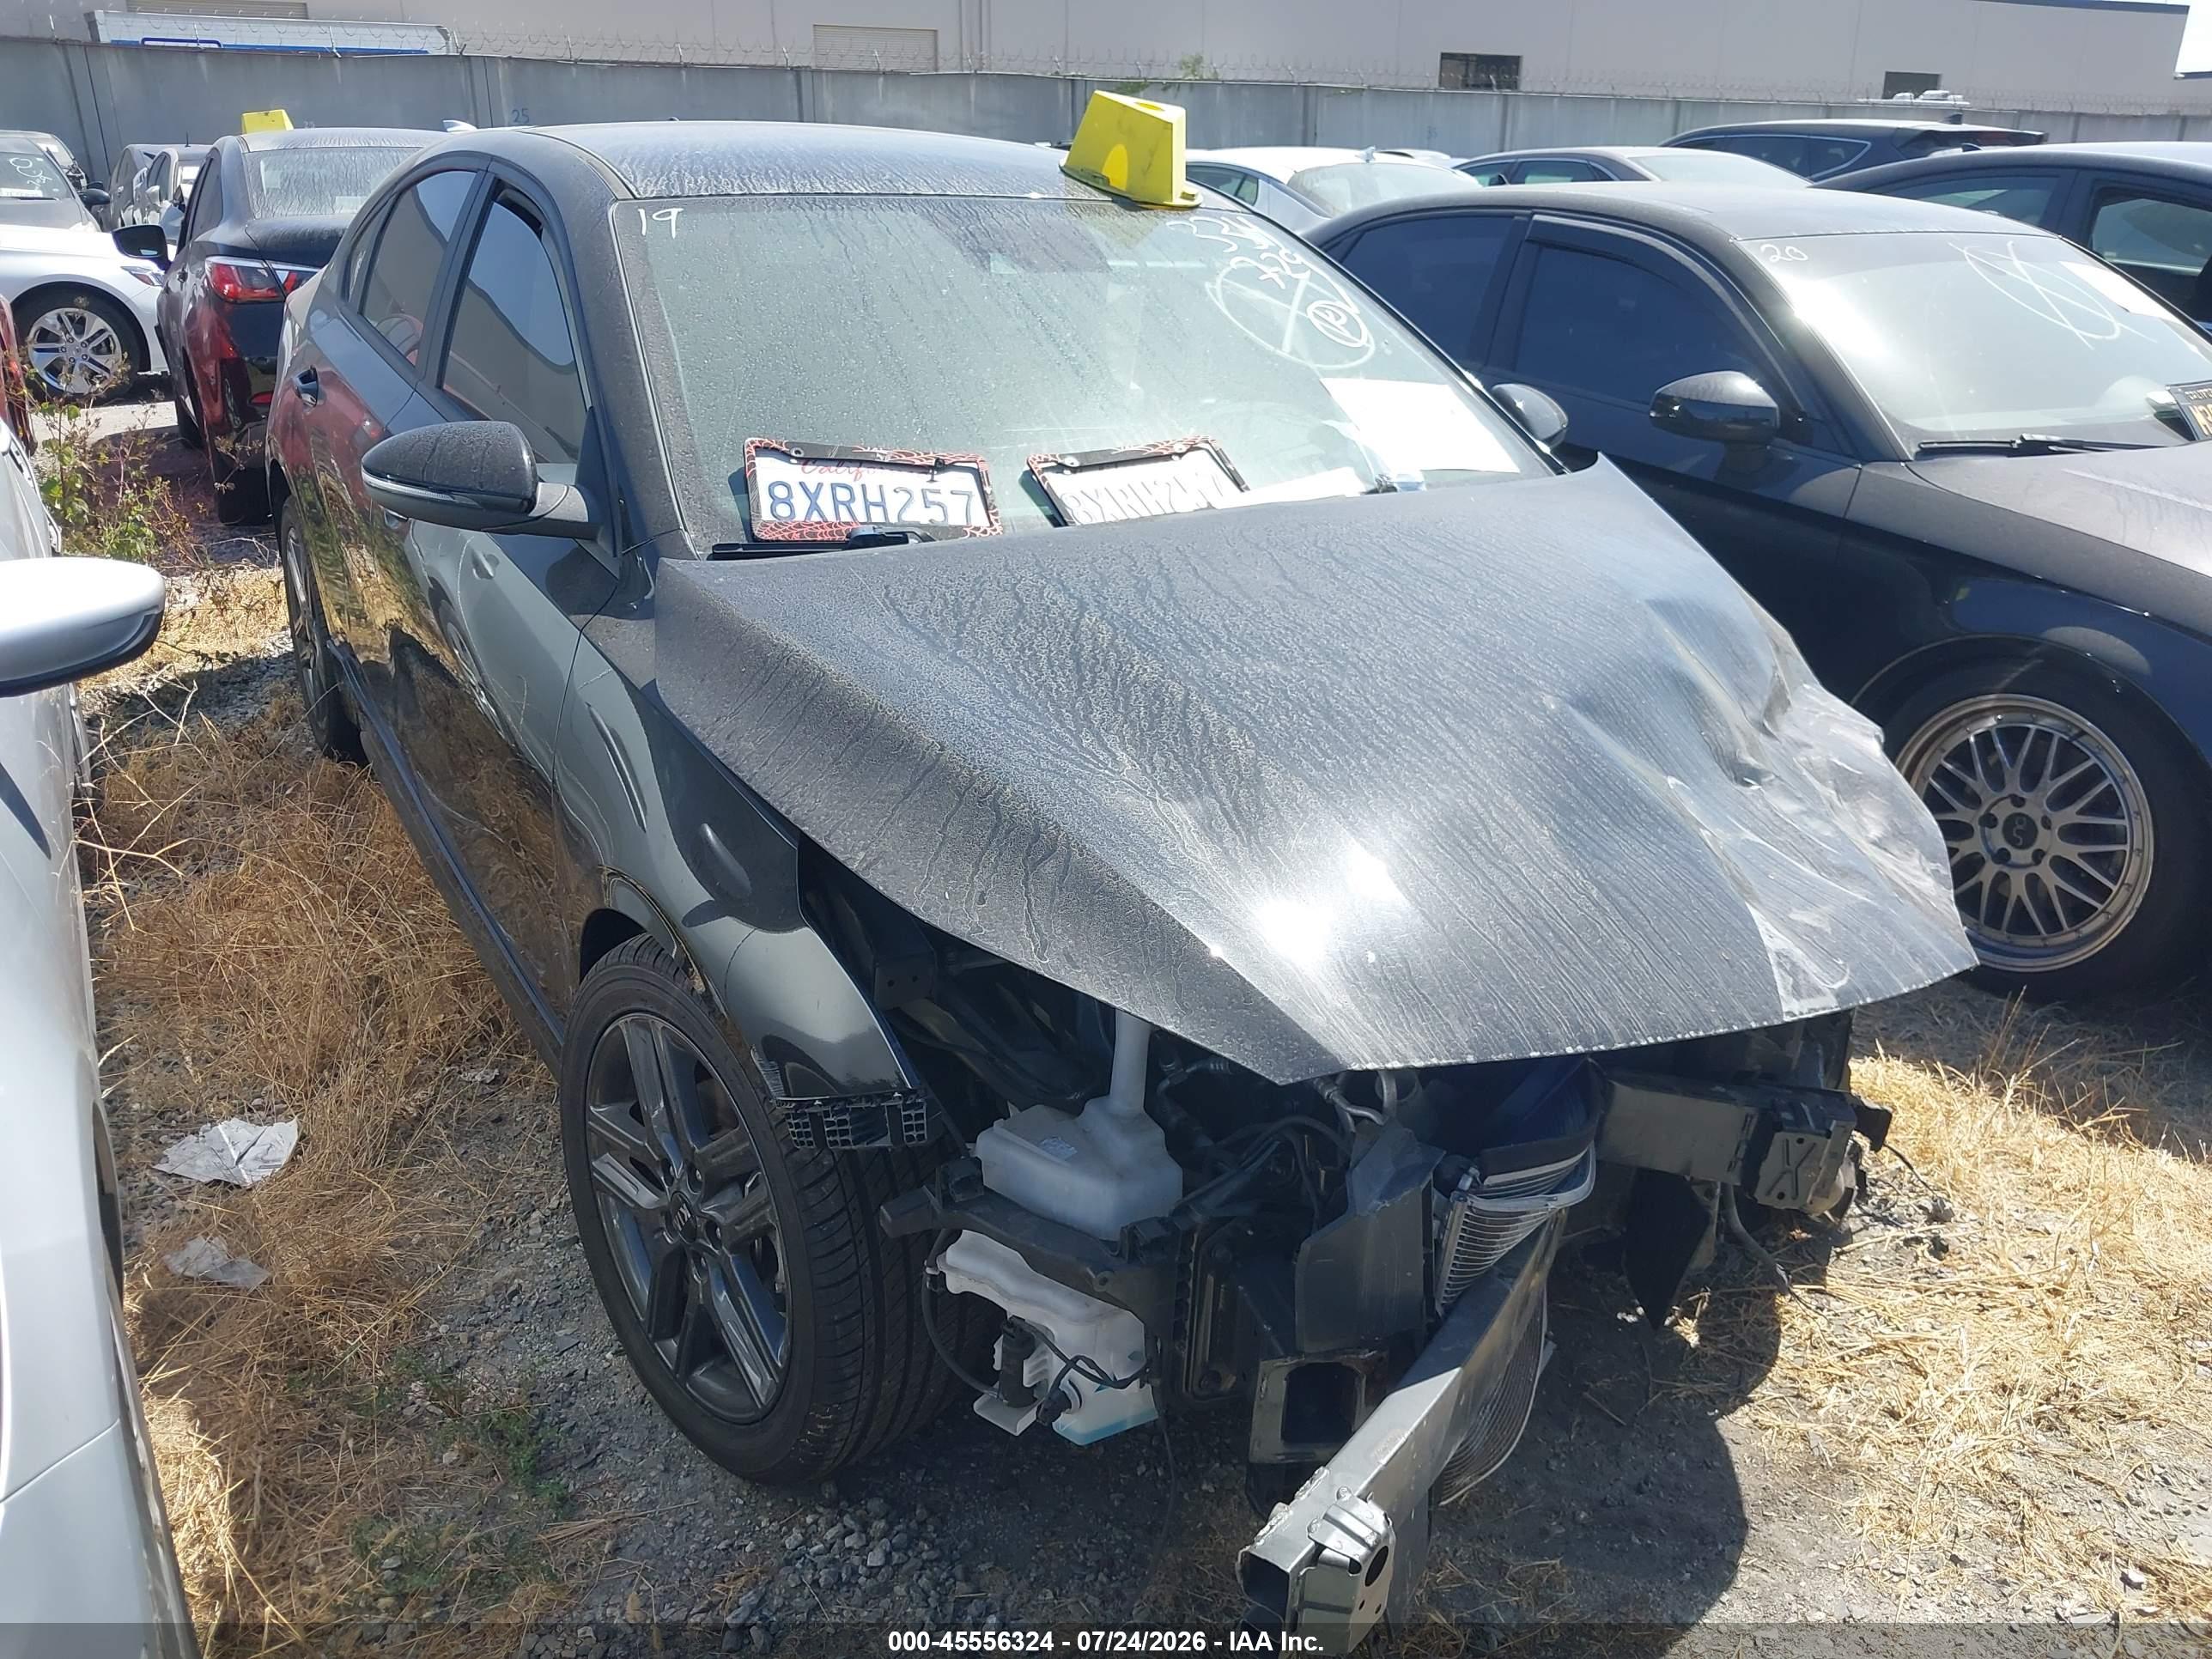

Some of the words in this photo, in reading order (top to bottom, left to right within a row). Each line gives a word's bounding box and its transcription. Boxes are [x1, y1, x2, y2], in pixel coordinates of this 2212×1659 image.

[511, 107, 530, 125] 25
[637, 207, 684, 239] 19
[1759, 243, 1808, 263] 20
[768, 480, 975, 526] 8XRH257
